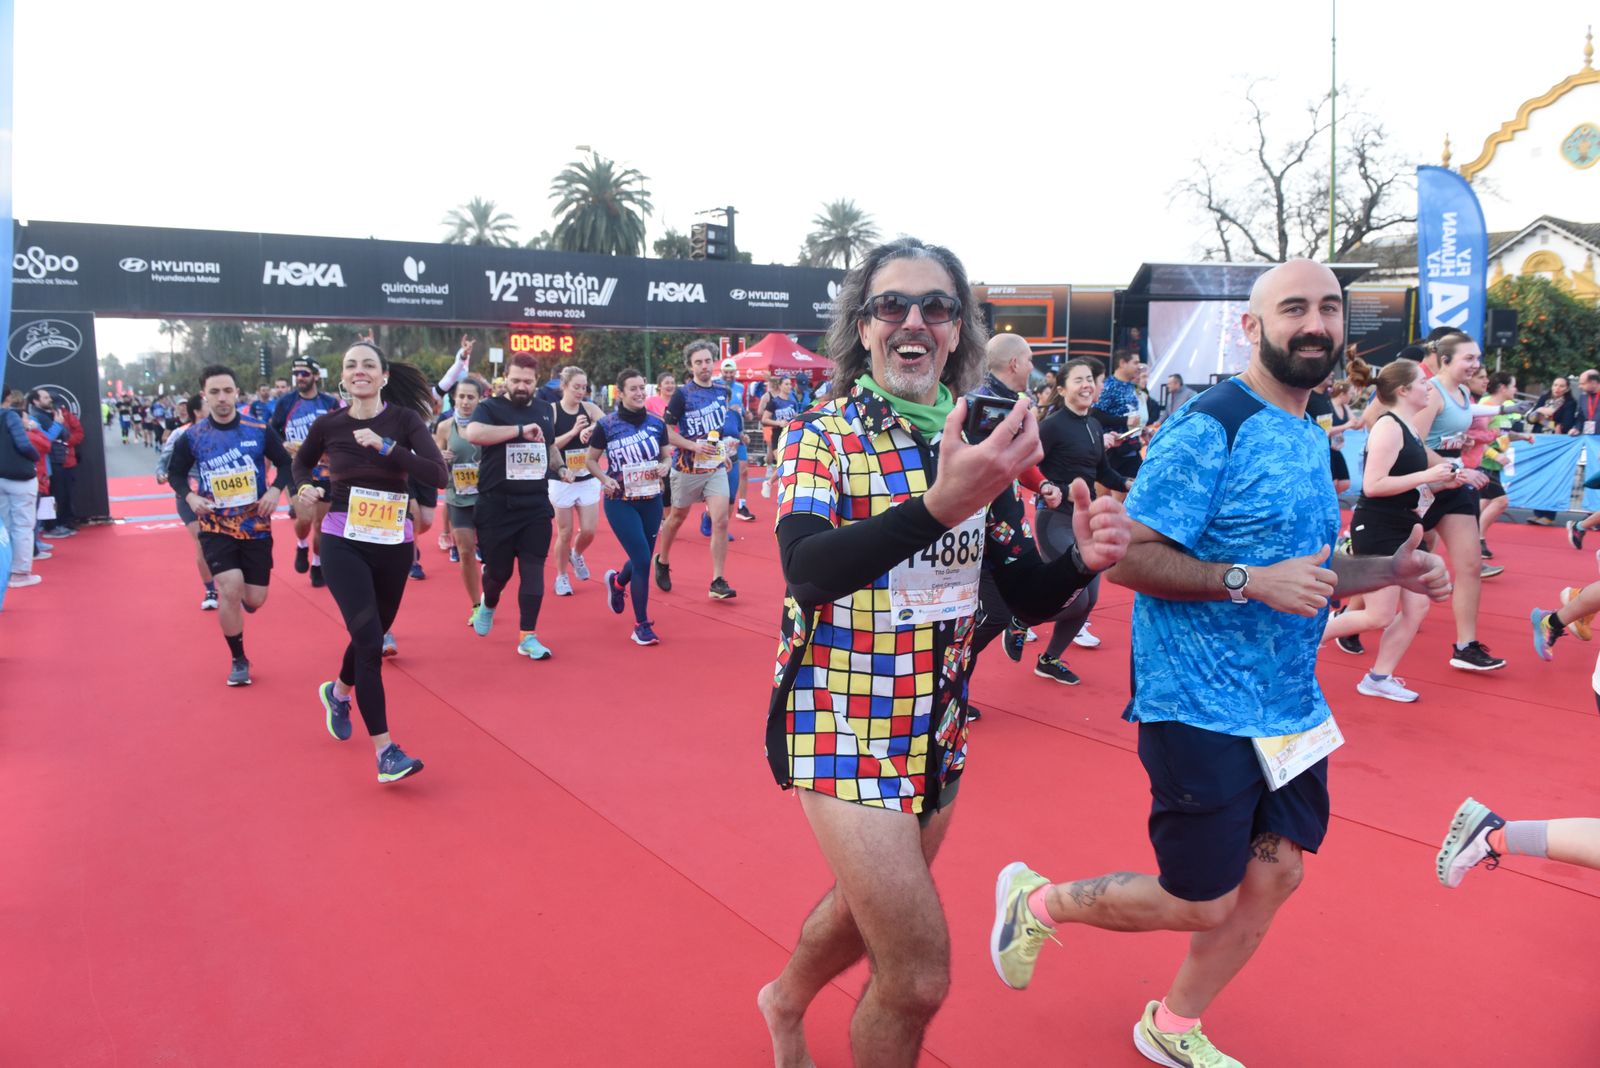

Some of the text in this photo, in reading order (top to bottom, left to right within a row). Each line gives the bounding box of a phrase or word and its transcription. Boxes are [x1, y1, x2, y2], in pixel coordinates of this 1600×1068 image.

[151, 259, 220, 273] HYUNDAI
[263, 261, 345, 288] HOKA
[510, 271, 599, 291] maratón
[535, 288, 600, 306] sevilla
[647, 281, 707, 304] HOKA
[748, 290, 789, 301] HYUNDAI
[524, 307, 586, 319] 28 enero 2024
[510, 452, 542, 464] 13764
[214, 475, 250, 491] 10481
[358, 501, 393, 520] 9711
